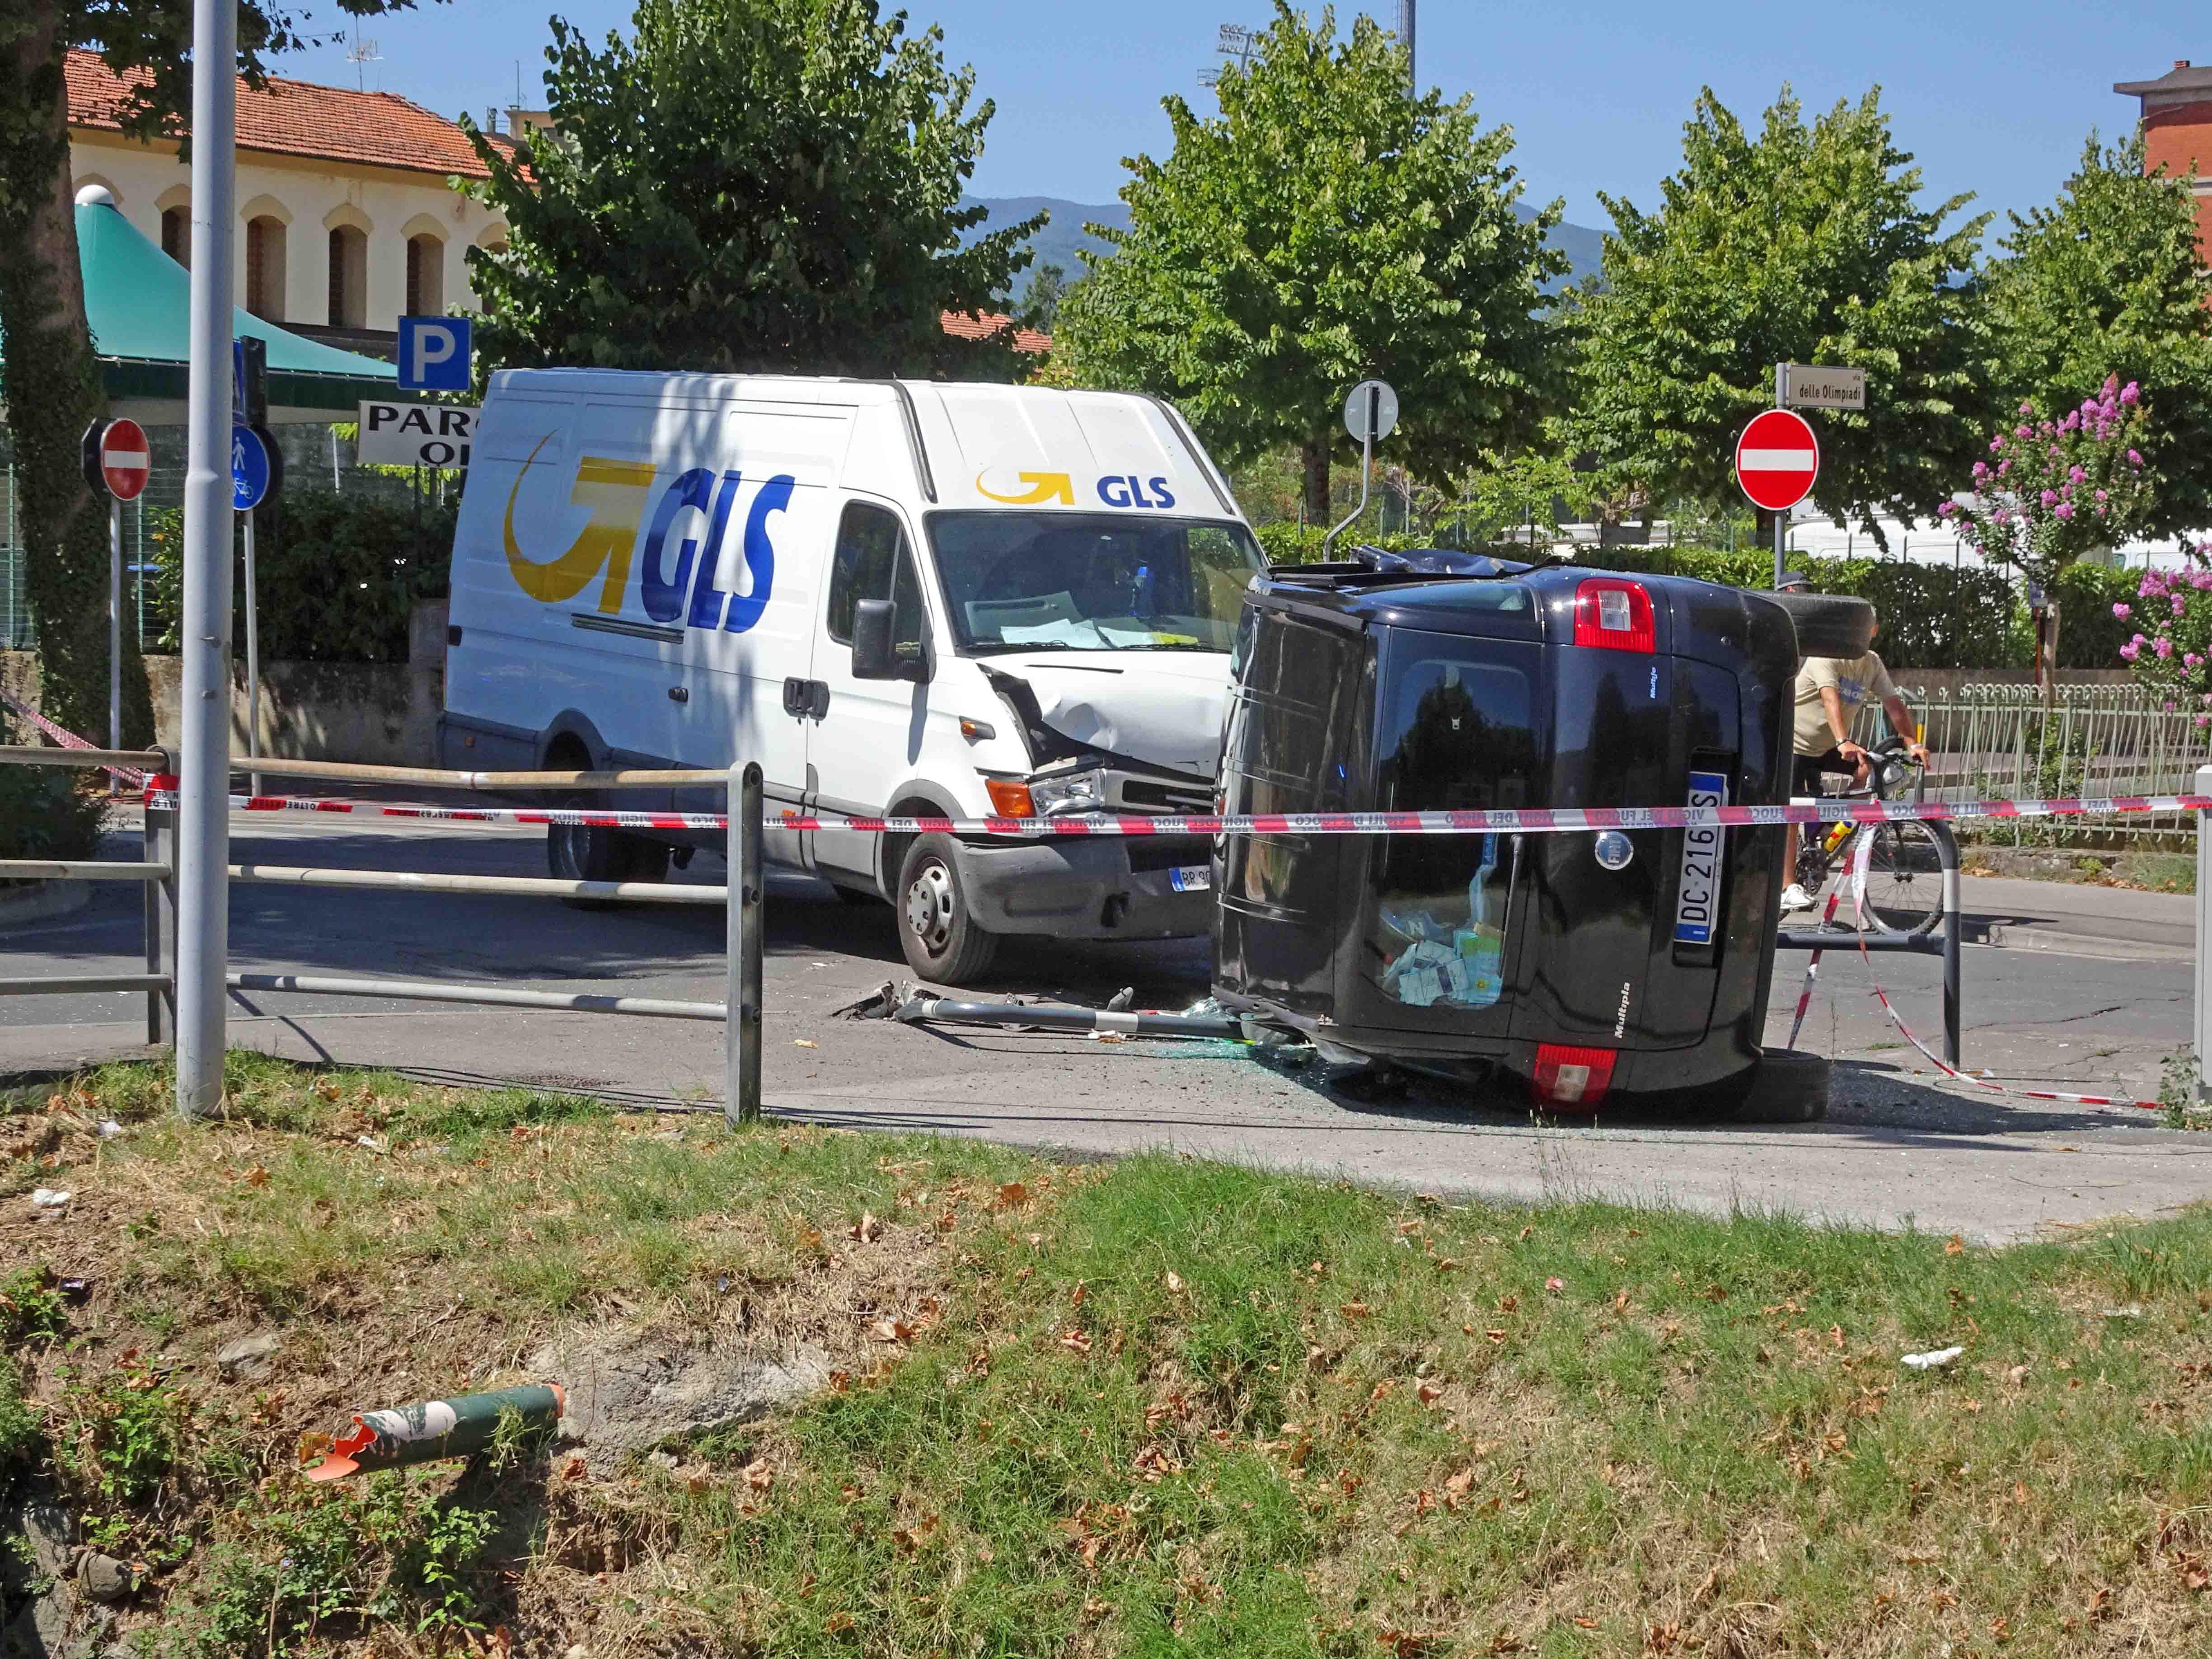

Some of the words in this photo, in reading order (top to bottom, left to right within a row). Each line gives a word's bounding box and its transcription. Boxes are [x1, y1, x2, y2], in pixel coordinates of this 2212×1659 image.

[413, 325, 455, 382] P
[1800, 384, 1820, 398] delle
[1823, 384, 1861, 403] Olimpiadi
[369, 405, 480, 437] PAR
[1097, 475, 1176, 509] GLS
[641, 468, 796, 633] GLS
[1614, 981, 1631, 1039] Multipla
